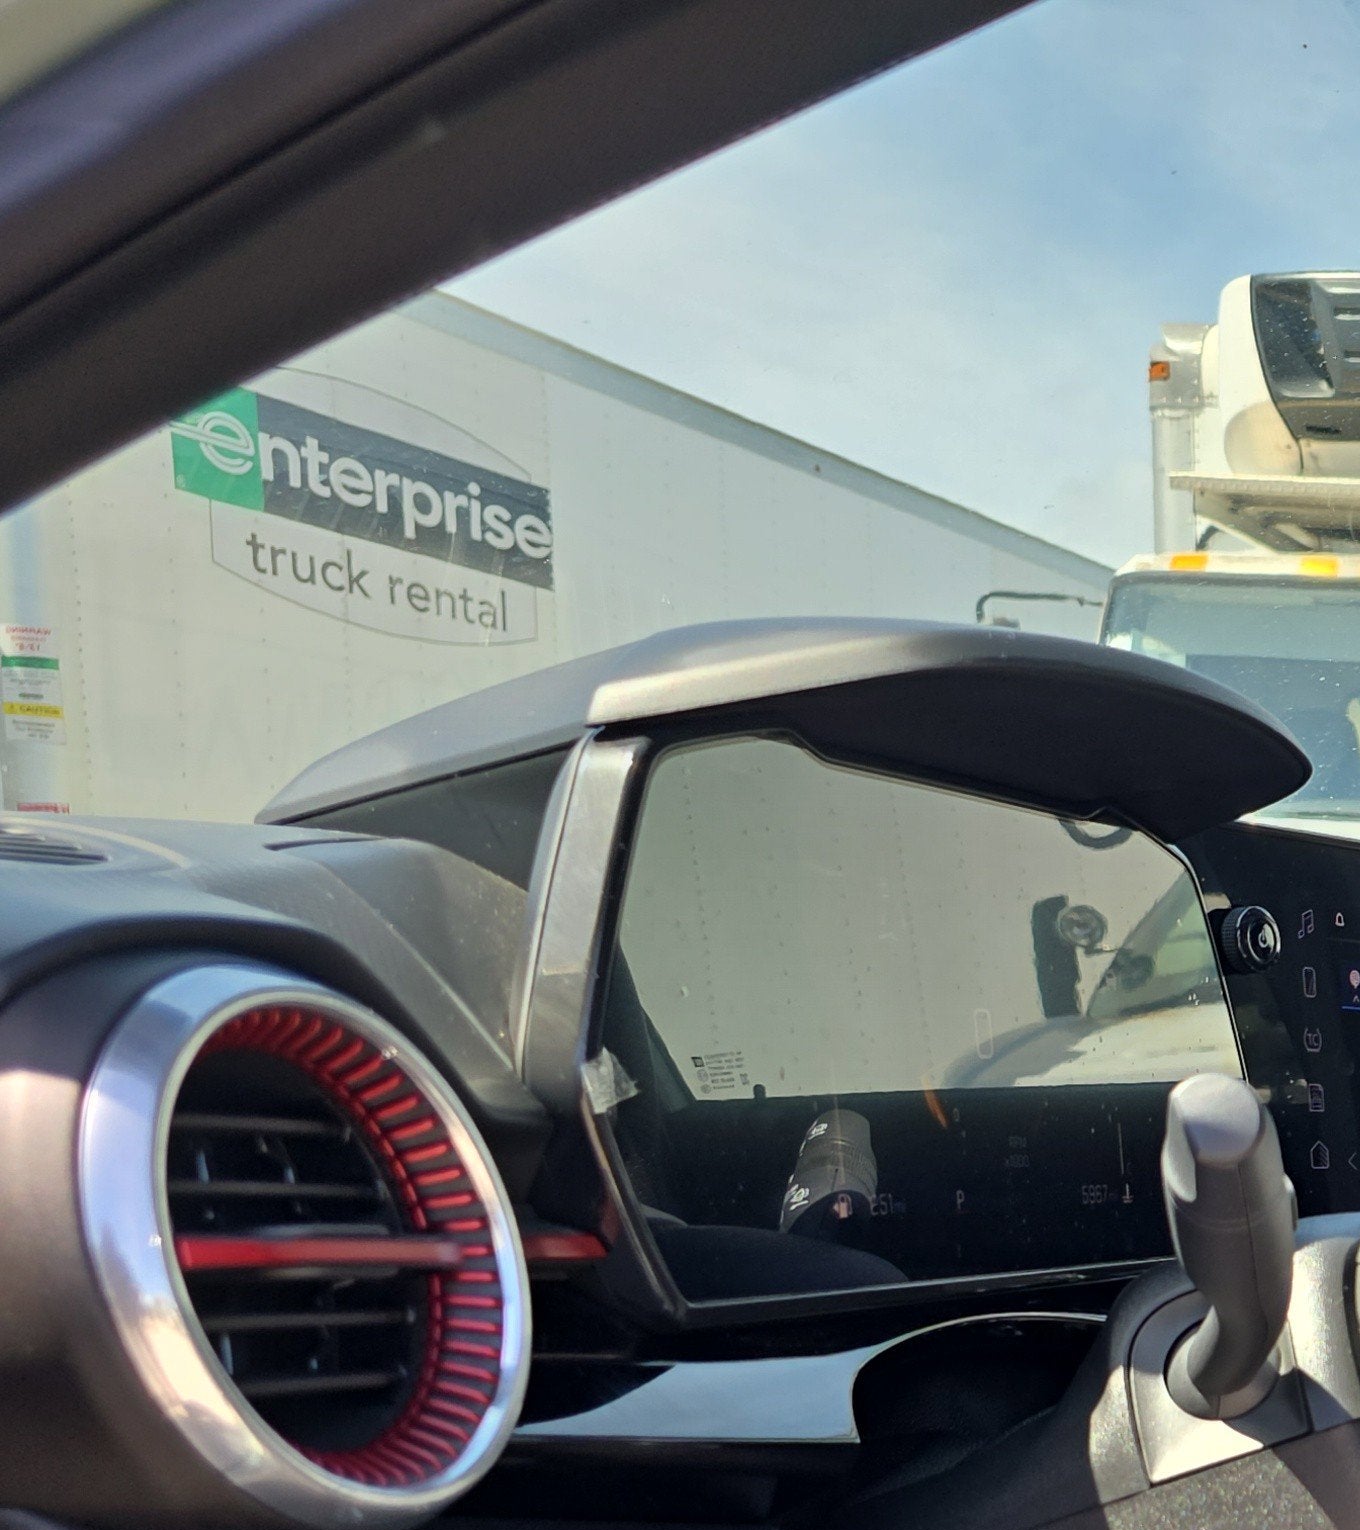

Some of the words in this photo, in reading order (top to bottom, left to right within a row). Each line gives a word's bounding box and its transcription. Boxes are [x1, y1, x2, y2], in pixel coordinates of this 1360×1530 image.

[171, 410, 553, 560] enterprise
[246, 532, 372, 598] truck
[388, 573, 508, 633] rental
[956, 1190, 965, 1210] P
